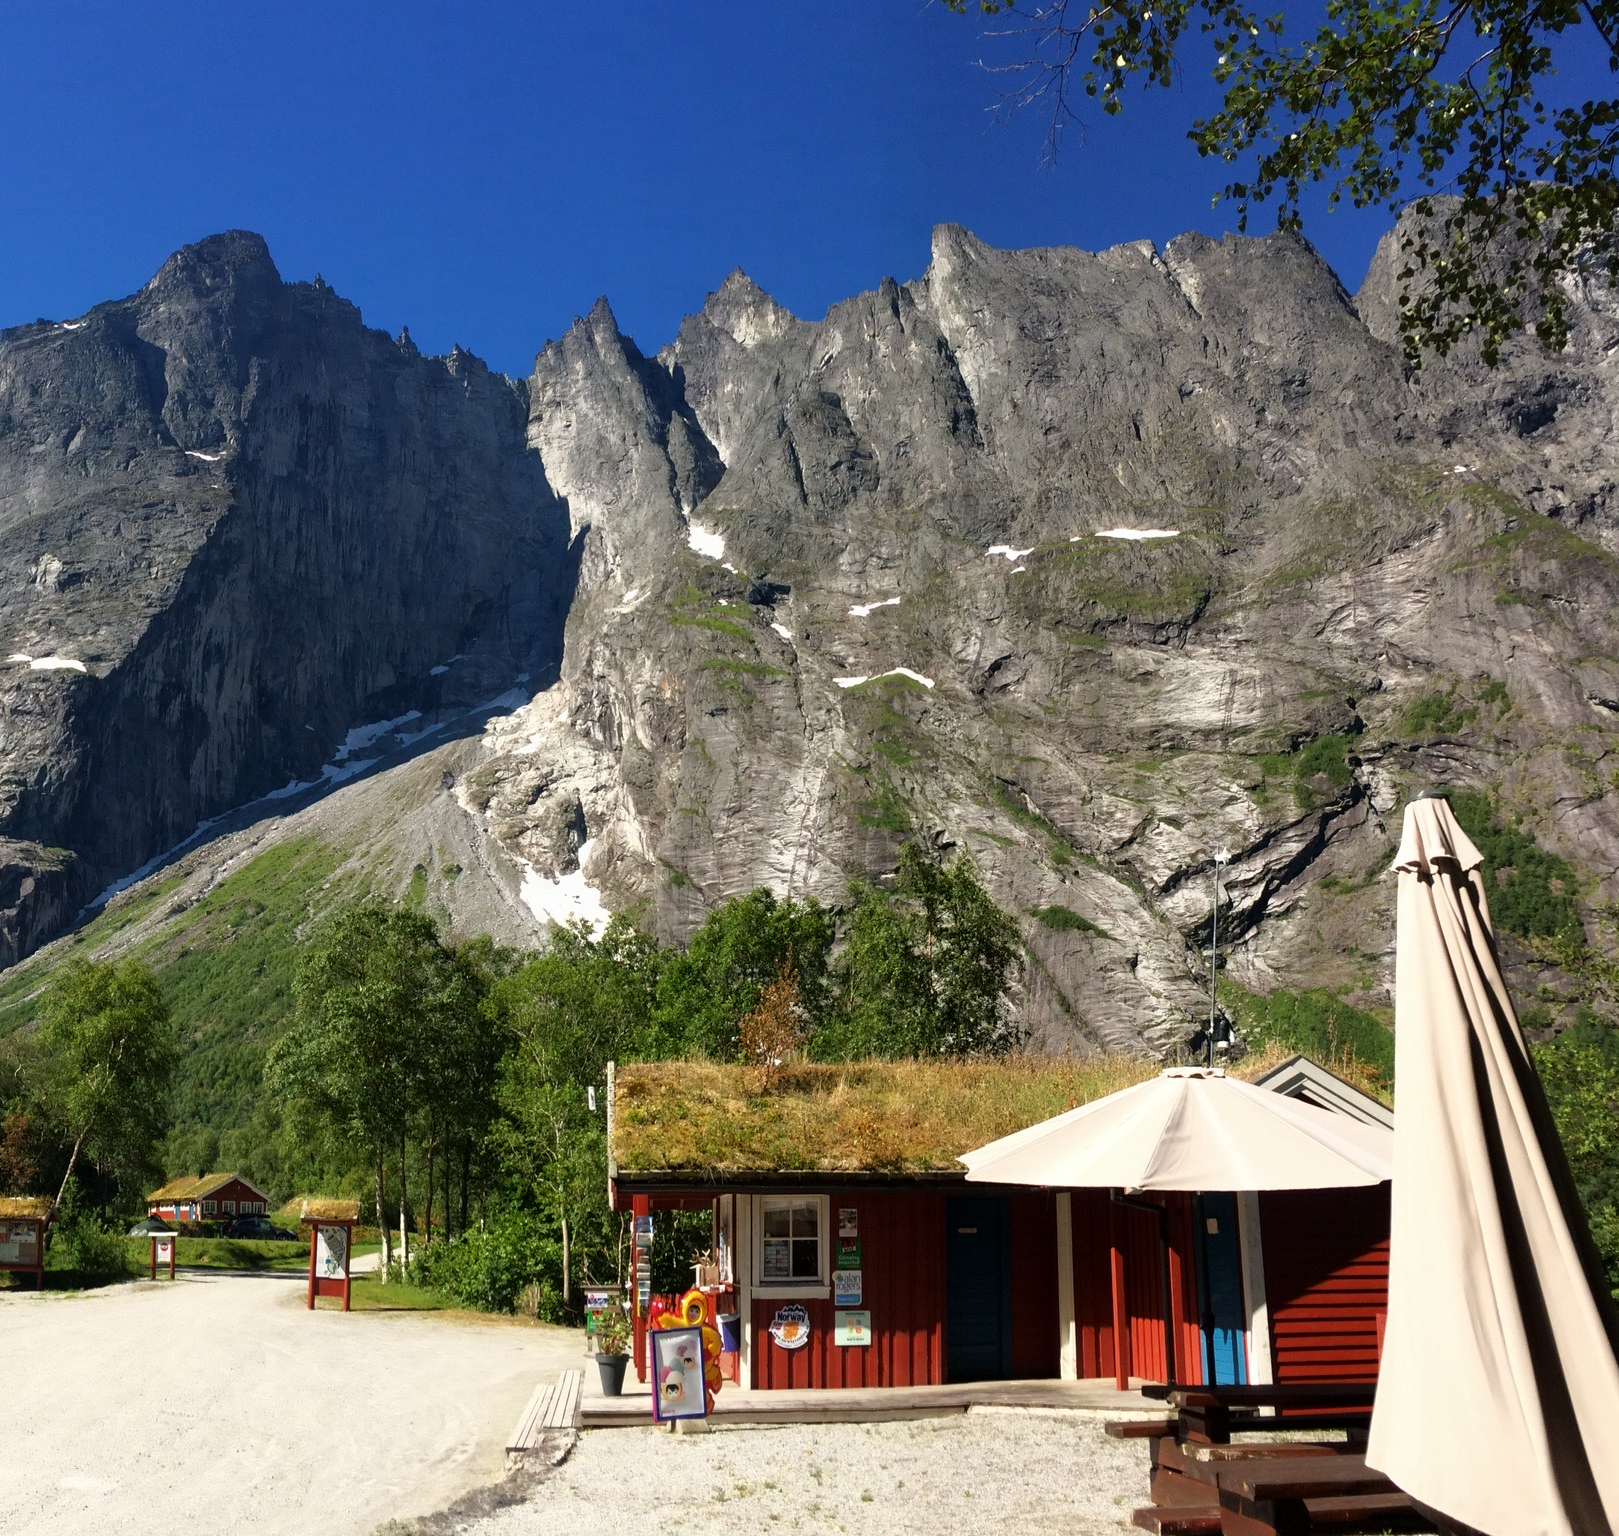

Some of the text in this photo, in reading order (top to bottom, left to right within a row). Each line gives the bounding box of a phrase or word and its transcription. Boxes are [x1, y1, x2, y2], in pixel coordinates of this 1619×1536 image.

[844, 1273, 860, 1283] alan
[836, 1282, 860, 1292] rogers
[777, 1311, 806, 1323] Norway
